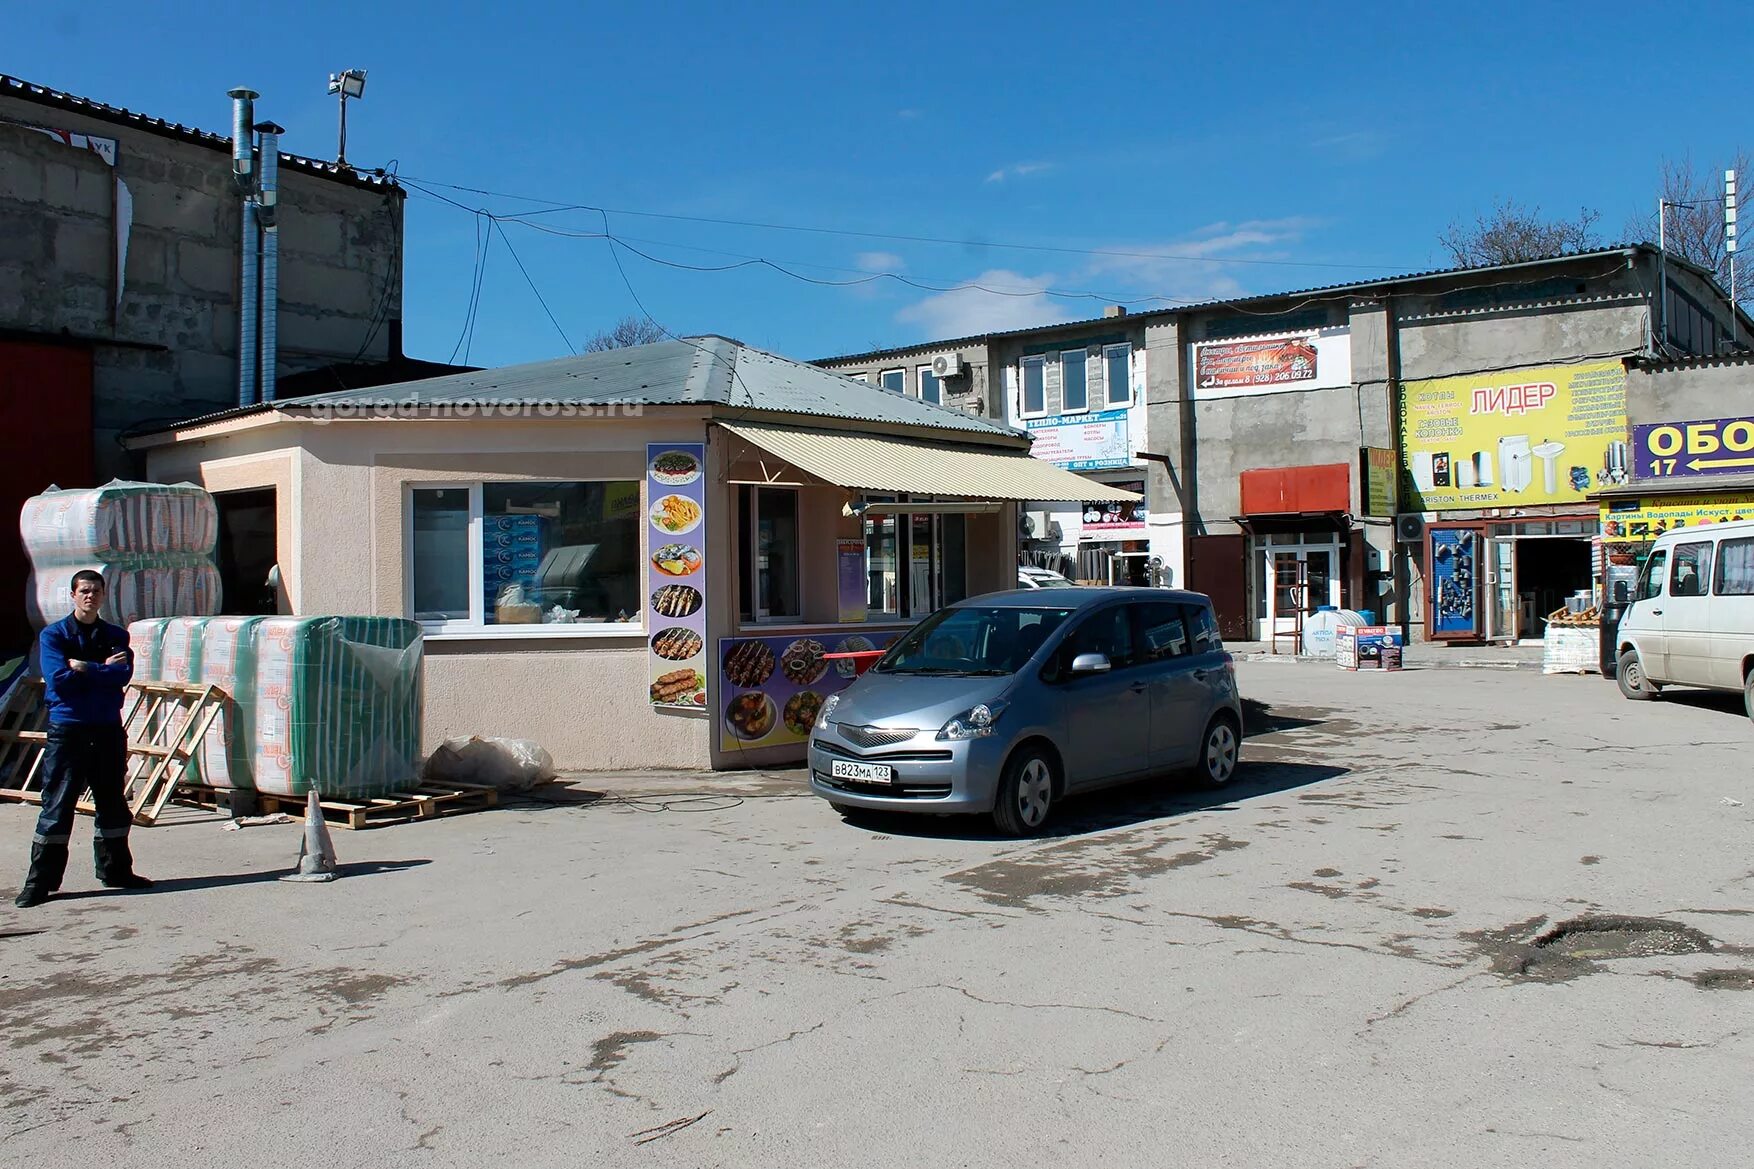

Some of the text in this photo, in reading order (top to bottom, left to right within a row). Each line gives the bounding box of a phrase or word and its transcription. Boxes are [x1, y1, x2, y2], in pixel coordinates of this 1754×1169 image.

[1244, 375, 1250, 384] 8
[1252, 373, 1273, 384] (928)
[1418, 391, 1455, 401] КОТЛЫ
[1472, 383, 1556, 415] ЛИДЕР
[1029, 414, 1100, 427] ТЕПЛО-МАРКЕТ
[1418, 418, 1458, 428] ГАЗОВЫЕ
[1415, 427, 1463, 438] КОЛОНКИ
[1647, 421, 1754, 457] ОБО
[1095, 458, 1128, 467] РОЗНИЦА
[1649, 459, 1677, 476] 17
[1420, 493, 1498, 504] ARISTON THERMEX
[1712, 497, 1738, 507] уют
[1605, 512, 1643, 521] Картины
[1647, 509, 1693, 519] Водопады
[1696, 507, 1733, 517] Искуст.
[835, 763, 889, 779] В823МА 123
